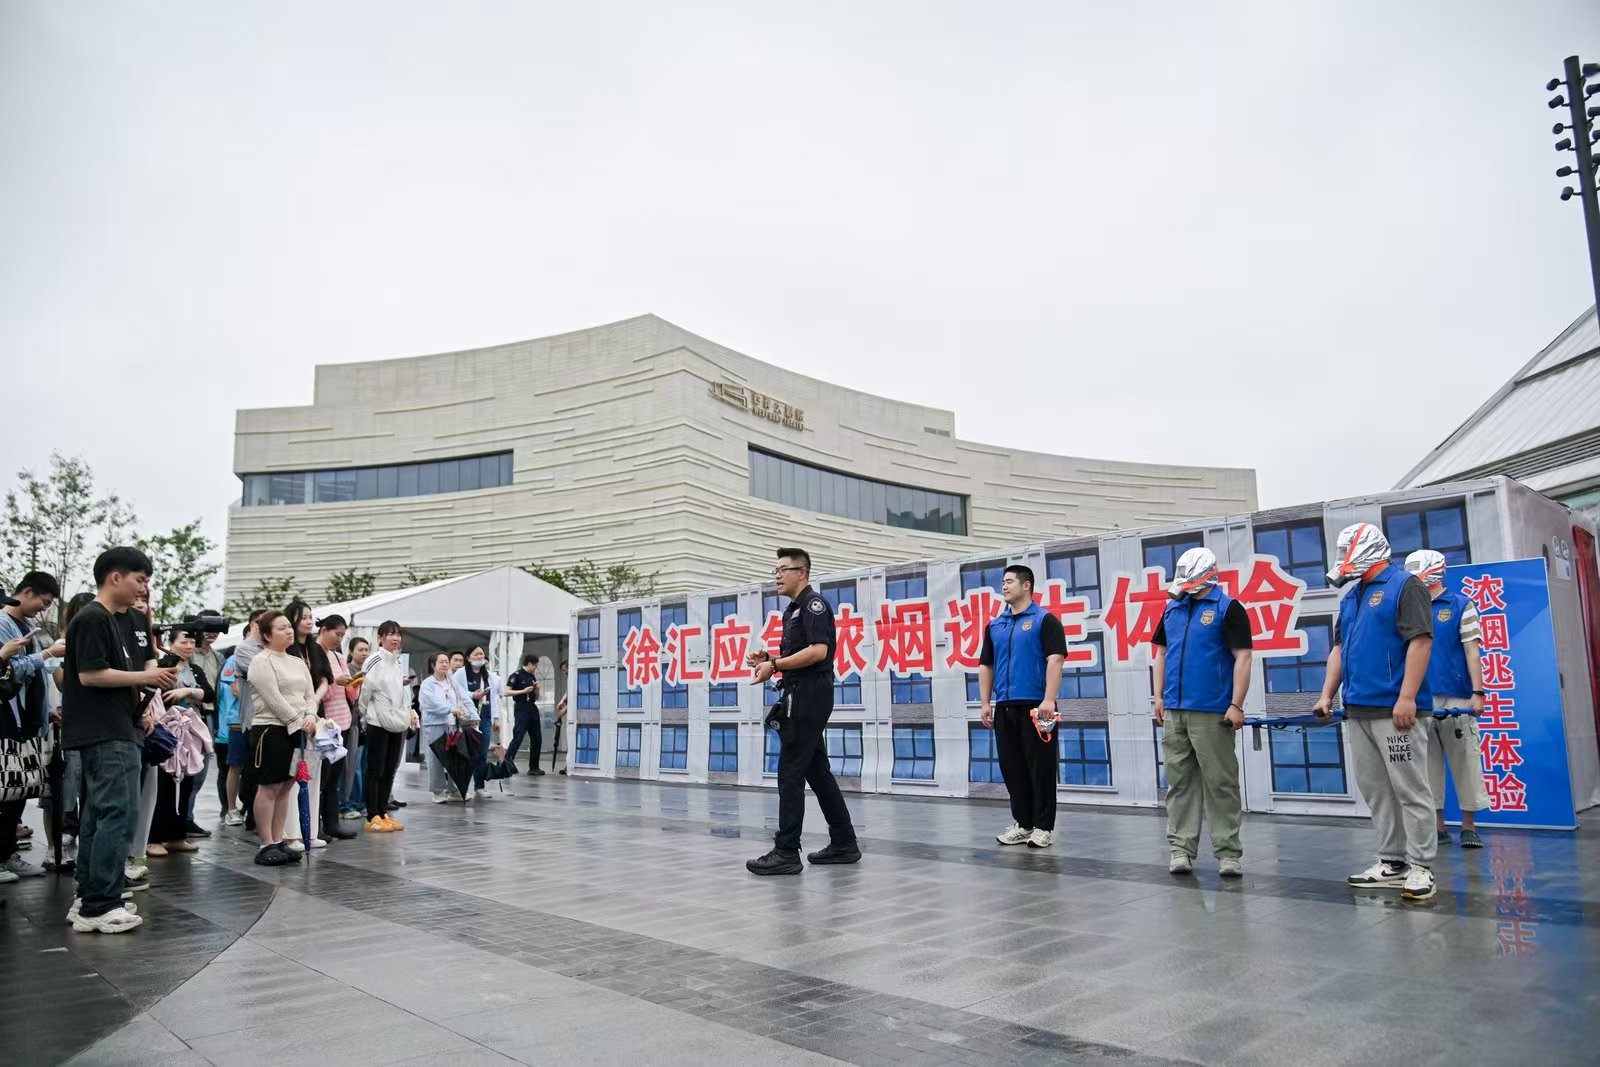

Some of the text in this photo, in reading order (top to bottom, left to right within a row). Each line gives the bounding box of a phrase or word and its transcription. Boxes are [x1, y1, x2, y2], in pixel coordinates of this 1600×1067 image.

[1386, 734, 1410, 744] NIKE
[1388, 743, 1411, 753] NIKE
[1389, 752, 1412, 763] NIKE
